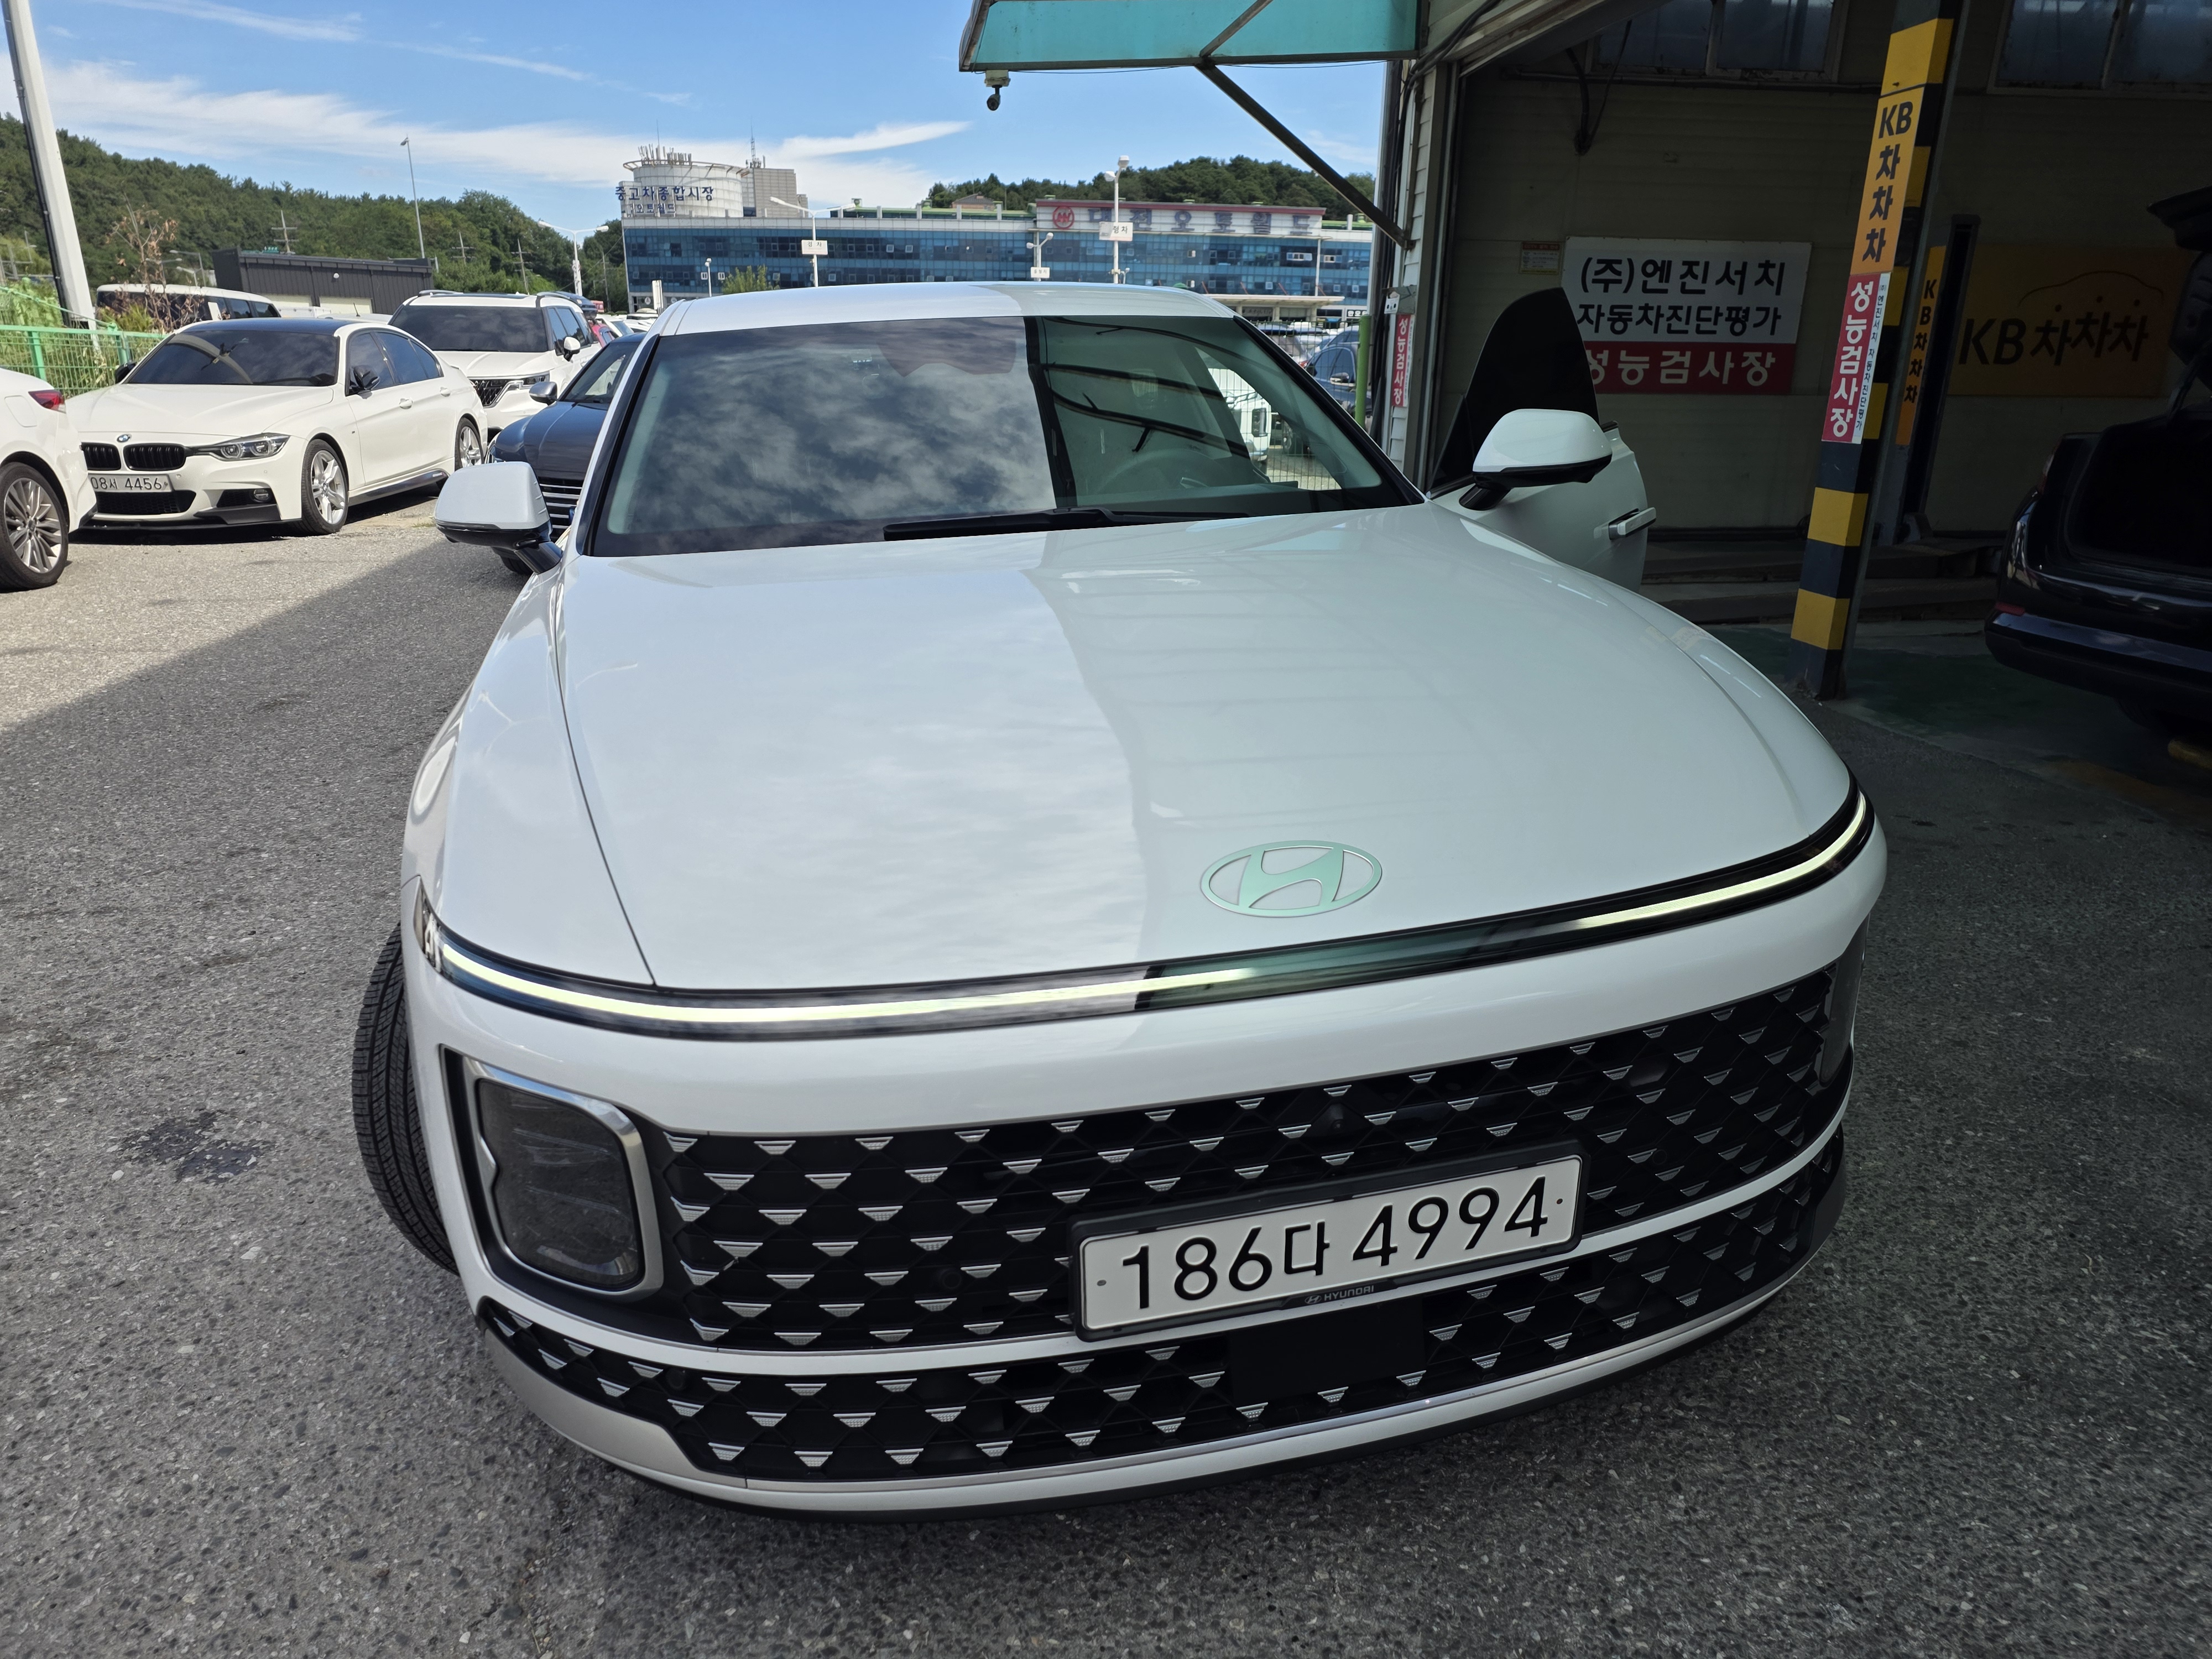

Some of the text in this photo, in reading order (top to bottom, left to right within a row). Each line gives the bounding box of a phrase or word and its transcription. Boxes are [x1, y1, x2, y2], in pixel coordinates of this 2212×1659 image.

[615, 186, 714, 201] 중고차종합시장
[1862, 101, 1913, 263] KB차차차
[622, 203, 676, 214] 오토월드
[1087, 207, 1313, 234] 대전오토월드
[1113, 225, 1128, 233] 형차
[1581, 257, 1786, 296] (주)엔진서치
[1577, 302, 1781, 337] 자동차진단평가
[1394, 317, 1408, 405] 성능검사장
[1586, 349, 1776, 387] 성능검사장
[1830, 281, 1874, 437] 성능검사장
[1855, 348, 1875, 431] 자동차진단평가
[90, 477, 162, 490] 08서 4456
[1121, 1176, 1549, 1309] 186다 4994
[1324, 1285, 1374, 1301] HYUNDAI
